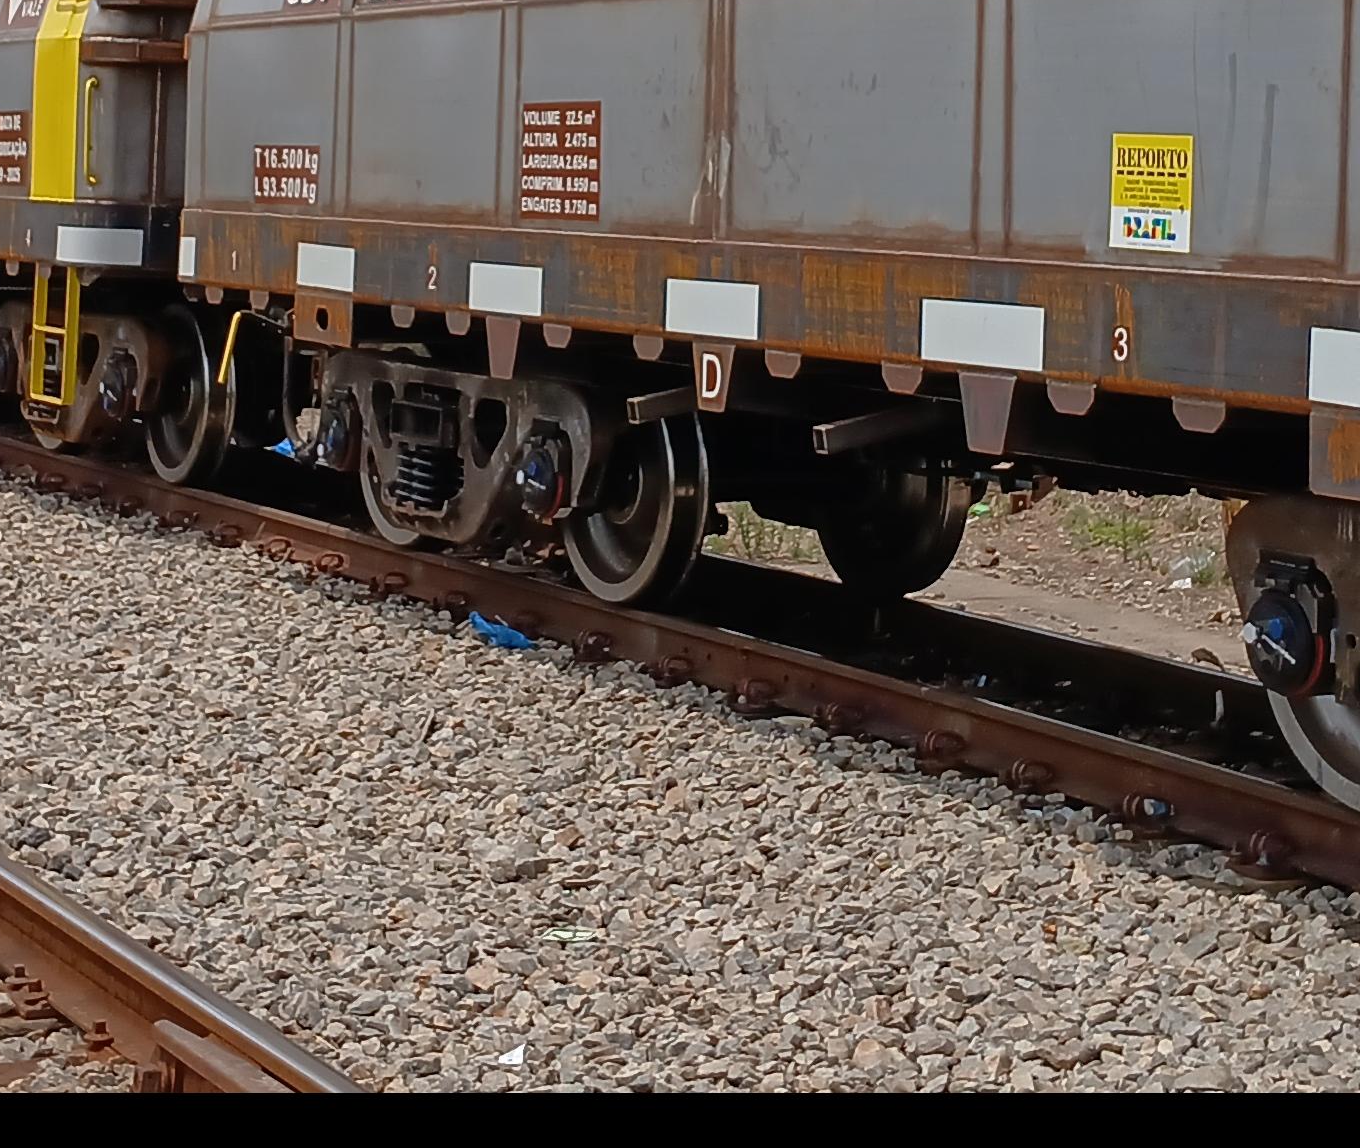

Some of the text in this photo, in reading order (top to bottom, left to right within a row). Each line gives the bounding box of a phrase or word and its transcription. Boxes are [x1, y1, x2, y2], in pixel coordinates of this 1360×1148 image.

[523, 110, 561, 126] VOLUME
[522, 132, 558, 147] ALTURA
[522, 154, 565, 169] LARGURA
[1116, 147, 1189, 170] REPORTO
[521, 196, 562, 214] ENGATES
[231, 250, 237, 271] 1
[427, 265, 437, 291] 2
[1113, 327, 1128, 362] 3
[701, 352, 722, 399] D
